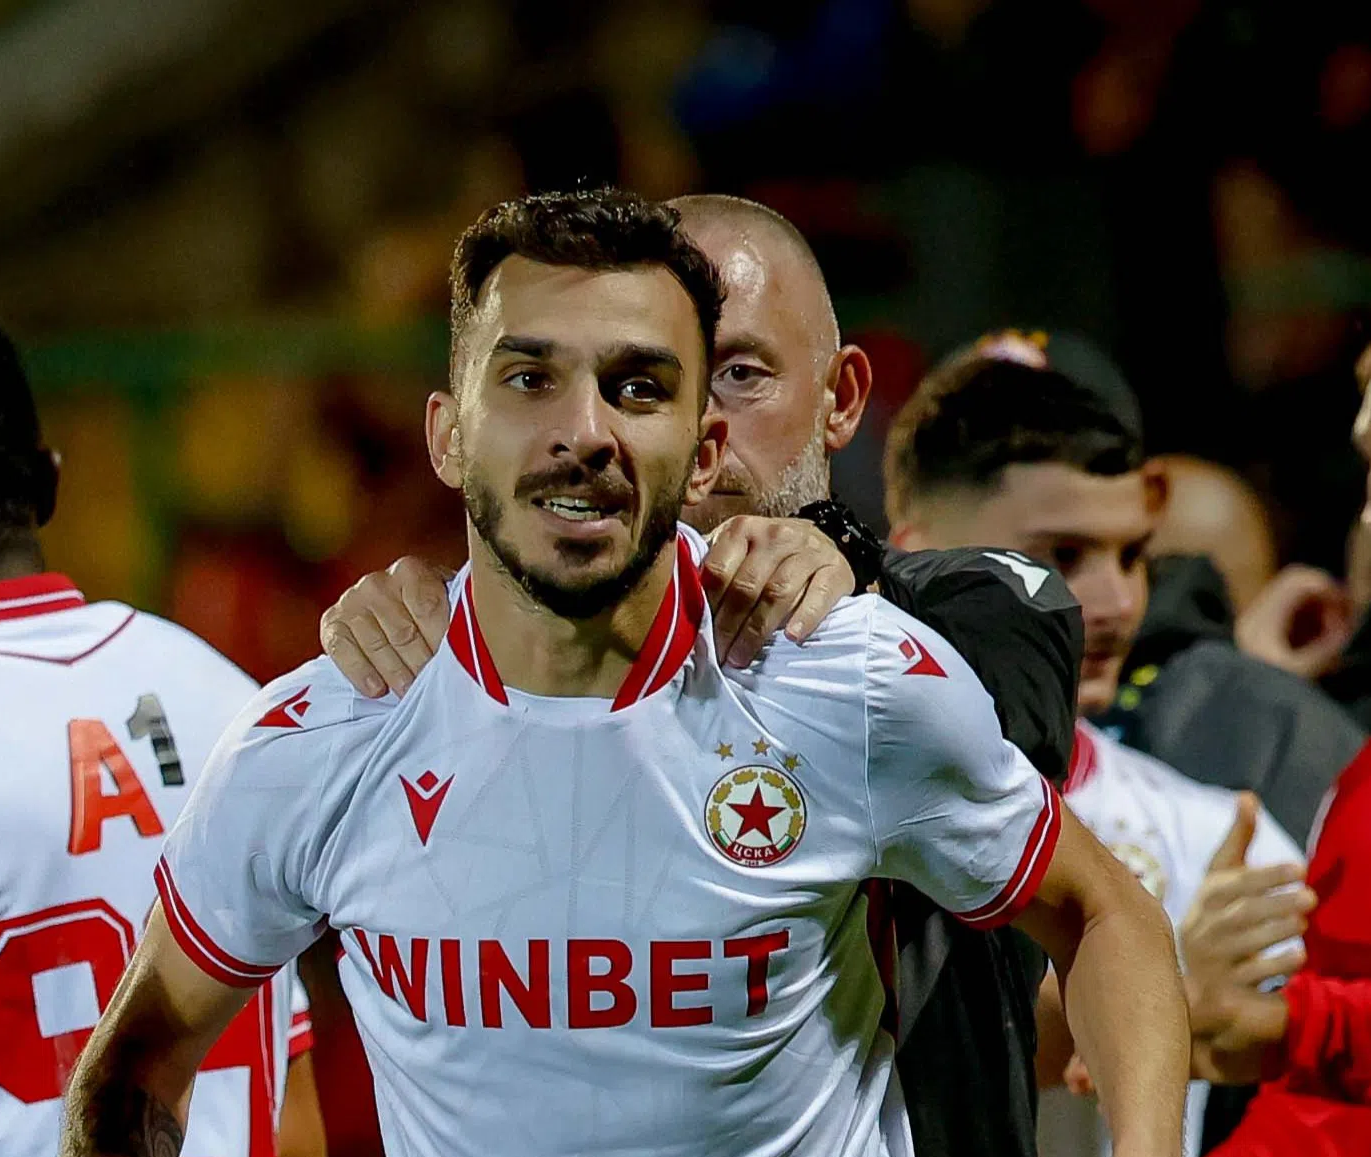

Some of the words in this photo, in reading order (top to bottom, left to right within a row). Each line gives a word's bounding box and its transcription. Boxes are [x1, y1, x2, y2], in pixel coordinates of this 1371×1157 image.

[67, 693, 187, 856] A1
[732, 843, 774, 858] ЦСКА
[352, 928, 789, 1030] WINBET
